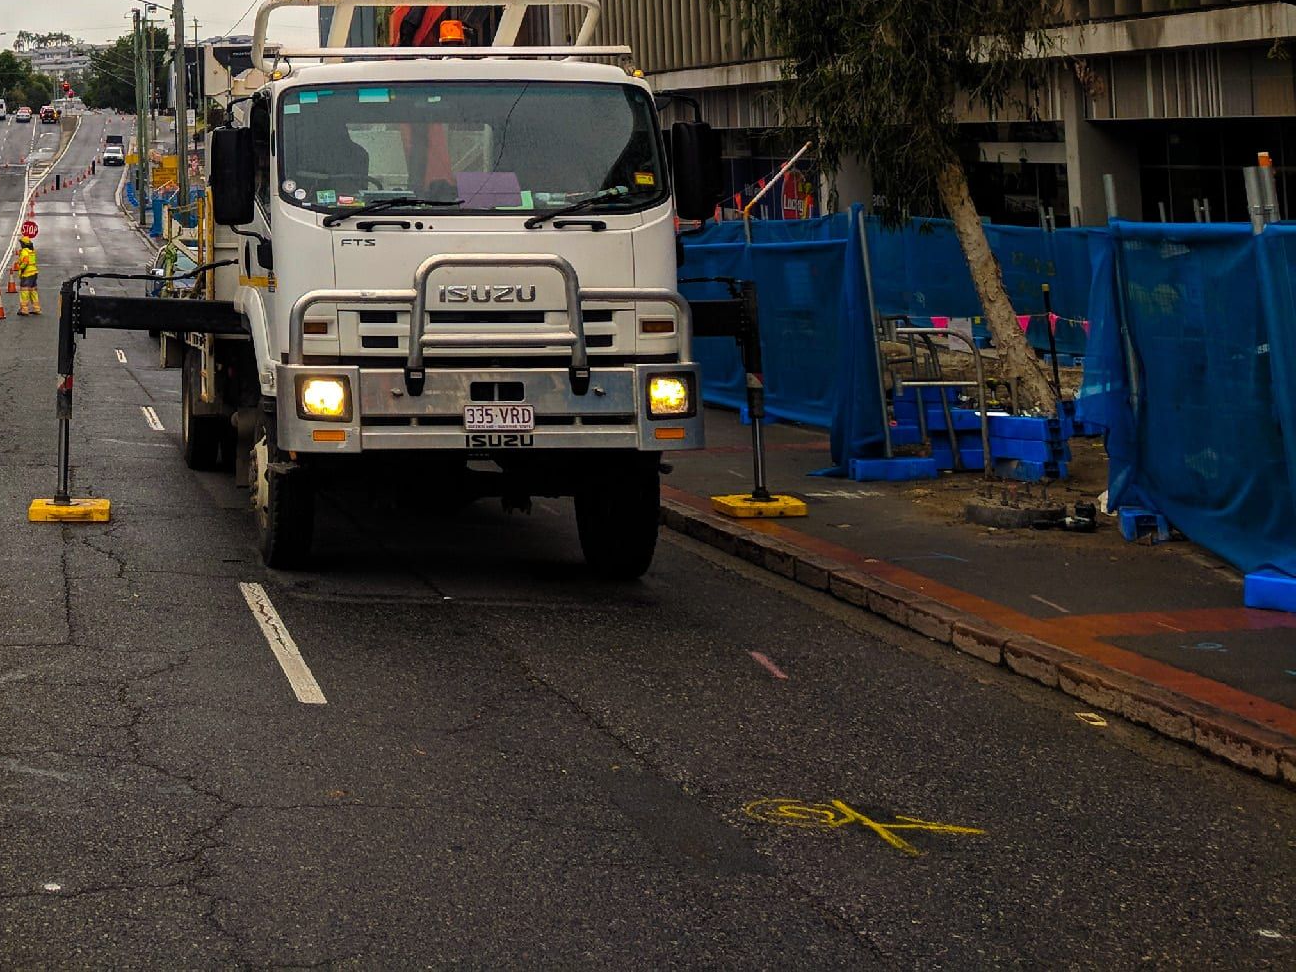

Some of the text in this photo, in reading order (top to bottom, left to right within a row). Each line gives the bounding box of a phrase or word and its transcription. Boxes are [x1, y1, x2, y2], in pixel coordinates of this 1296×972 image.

[22, 224, 38, 235] STOP
[340, 238, 376, 247] FTS
[438, 283, 536, 304] ISUZU
[465, 434, 534, 448] ISUZU
